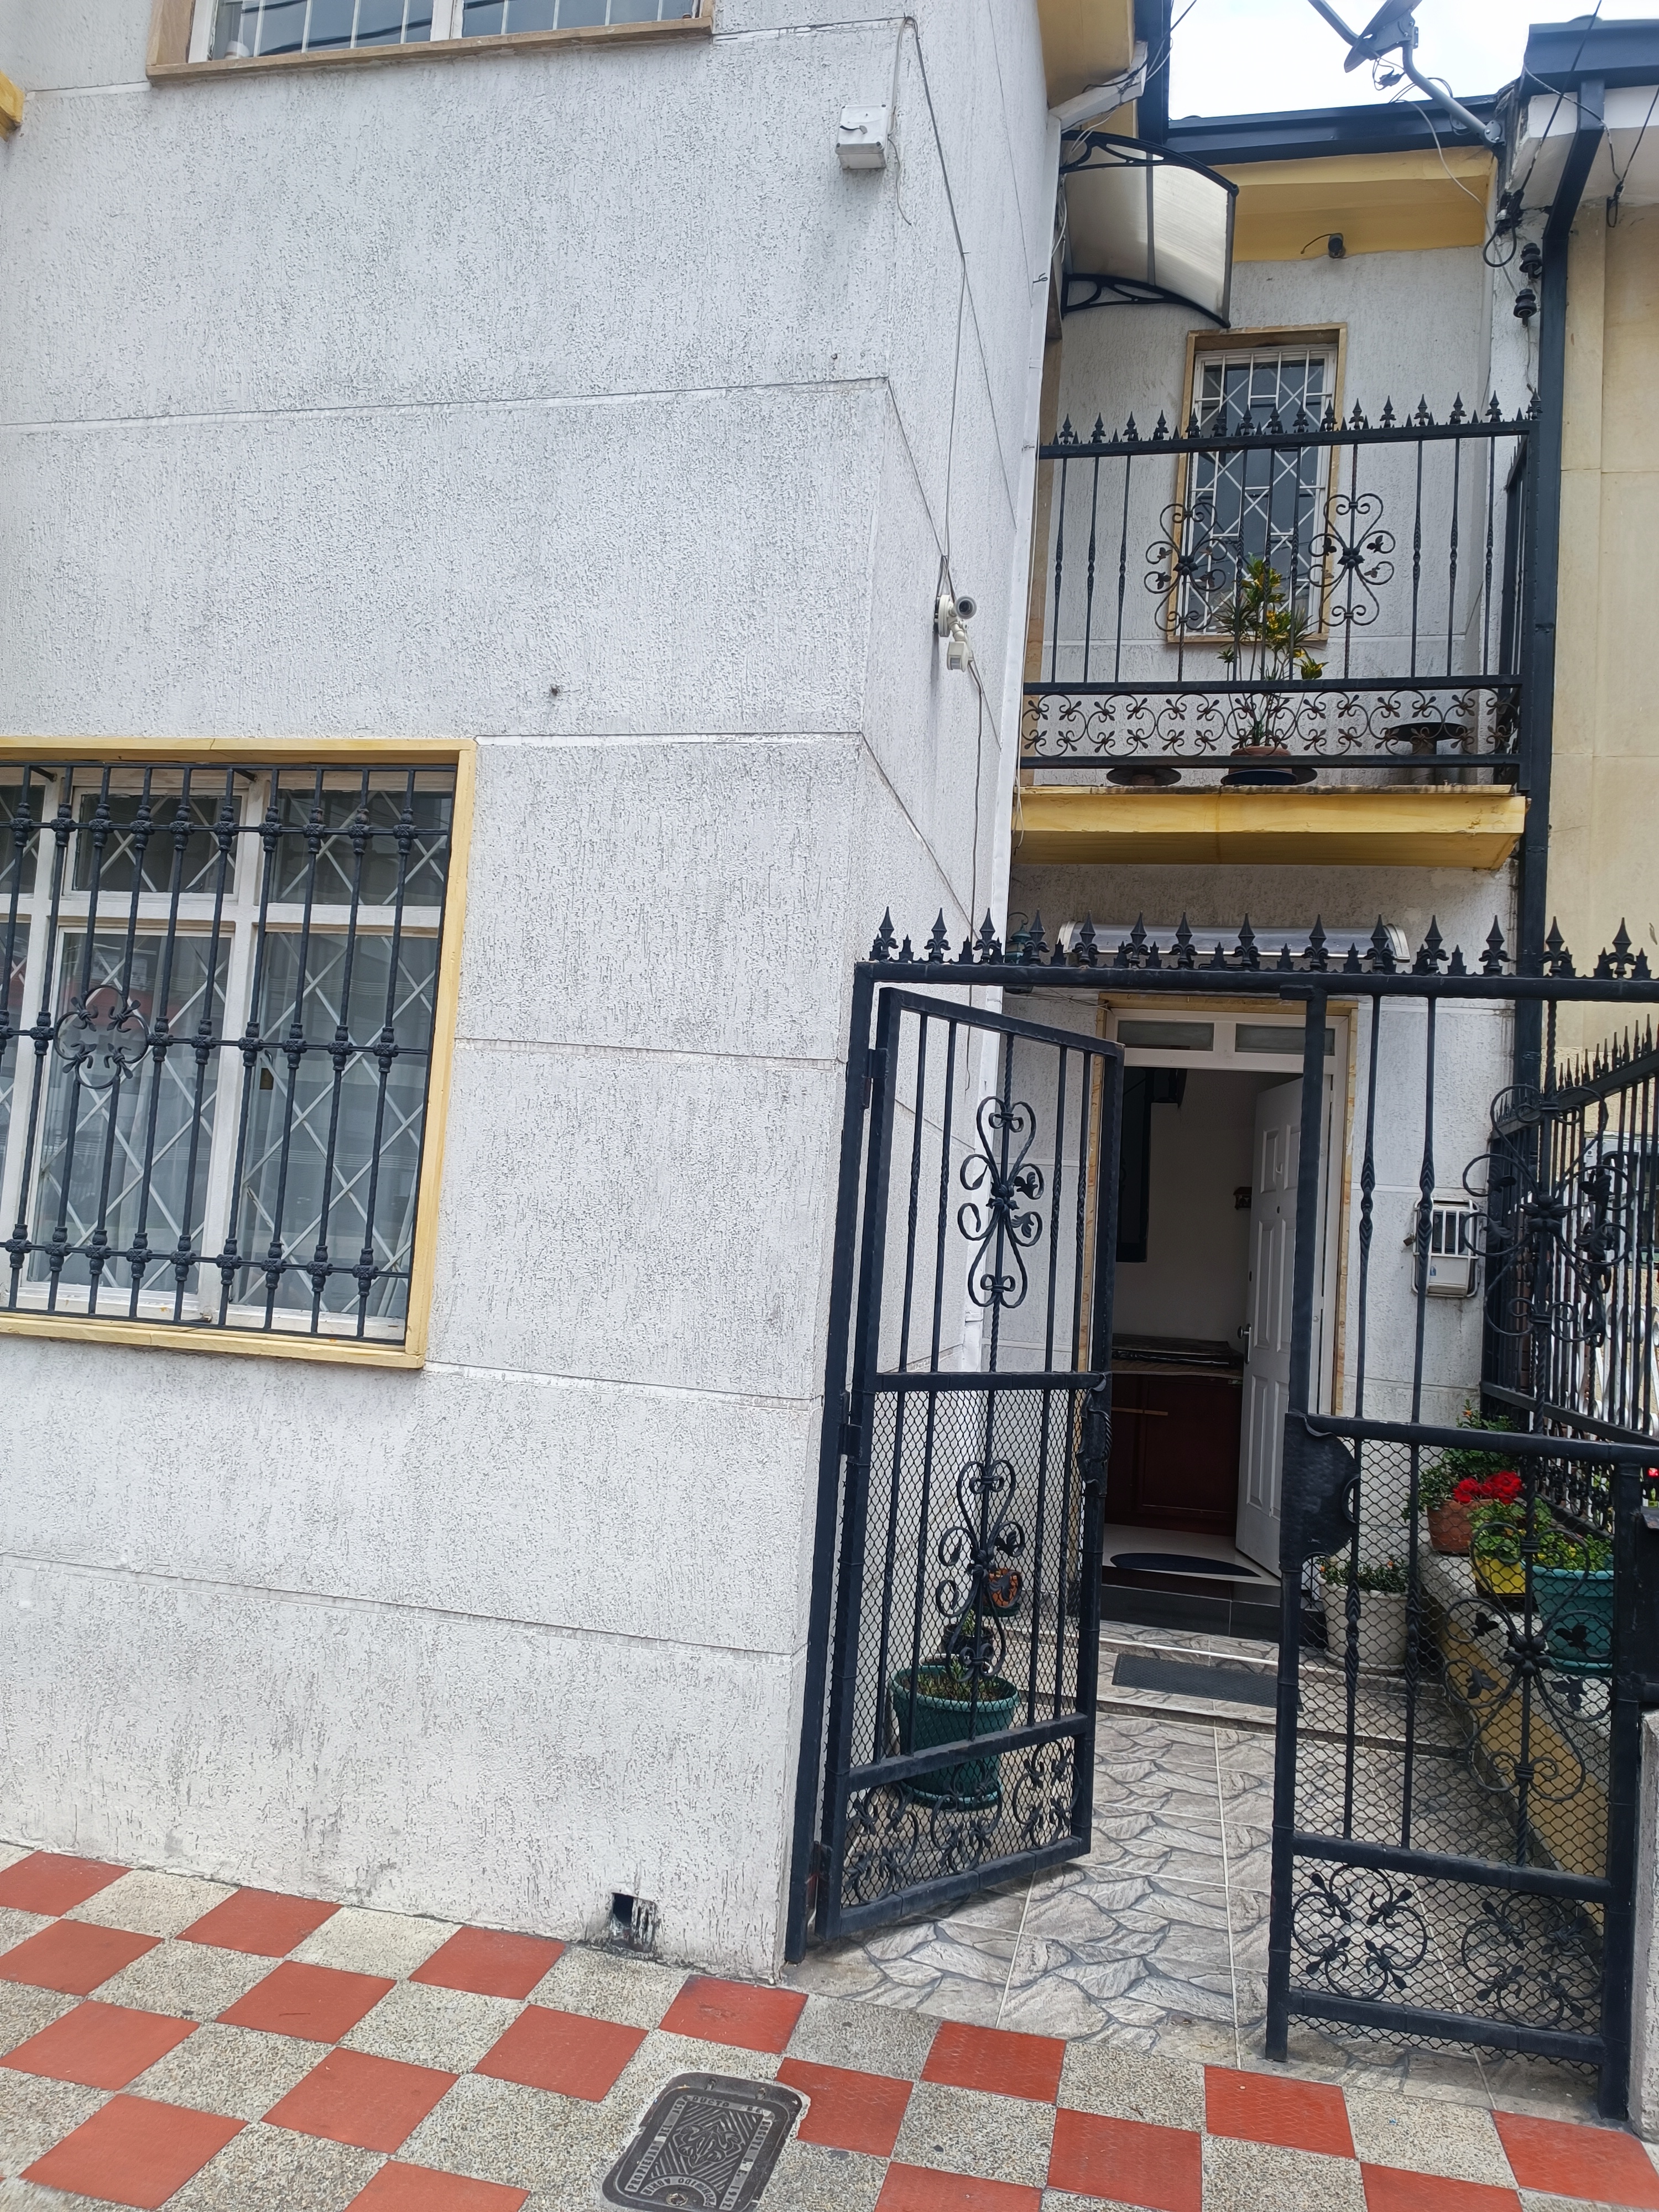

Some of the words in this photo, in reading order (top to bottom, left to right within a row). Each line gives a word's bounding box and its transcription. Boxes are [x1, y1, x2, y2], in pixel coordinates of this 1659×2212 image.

[627, 2146, 660, 2189] PROPIEDAD
[658, 2125, 672, 2137] DEL
[722, 2185, 740, 2208] 1962
[643, 2178, 671, 2194] ABRIR
[678, 2177, 716, 2207] PROHIDO
